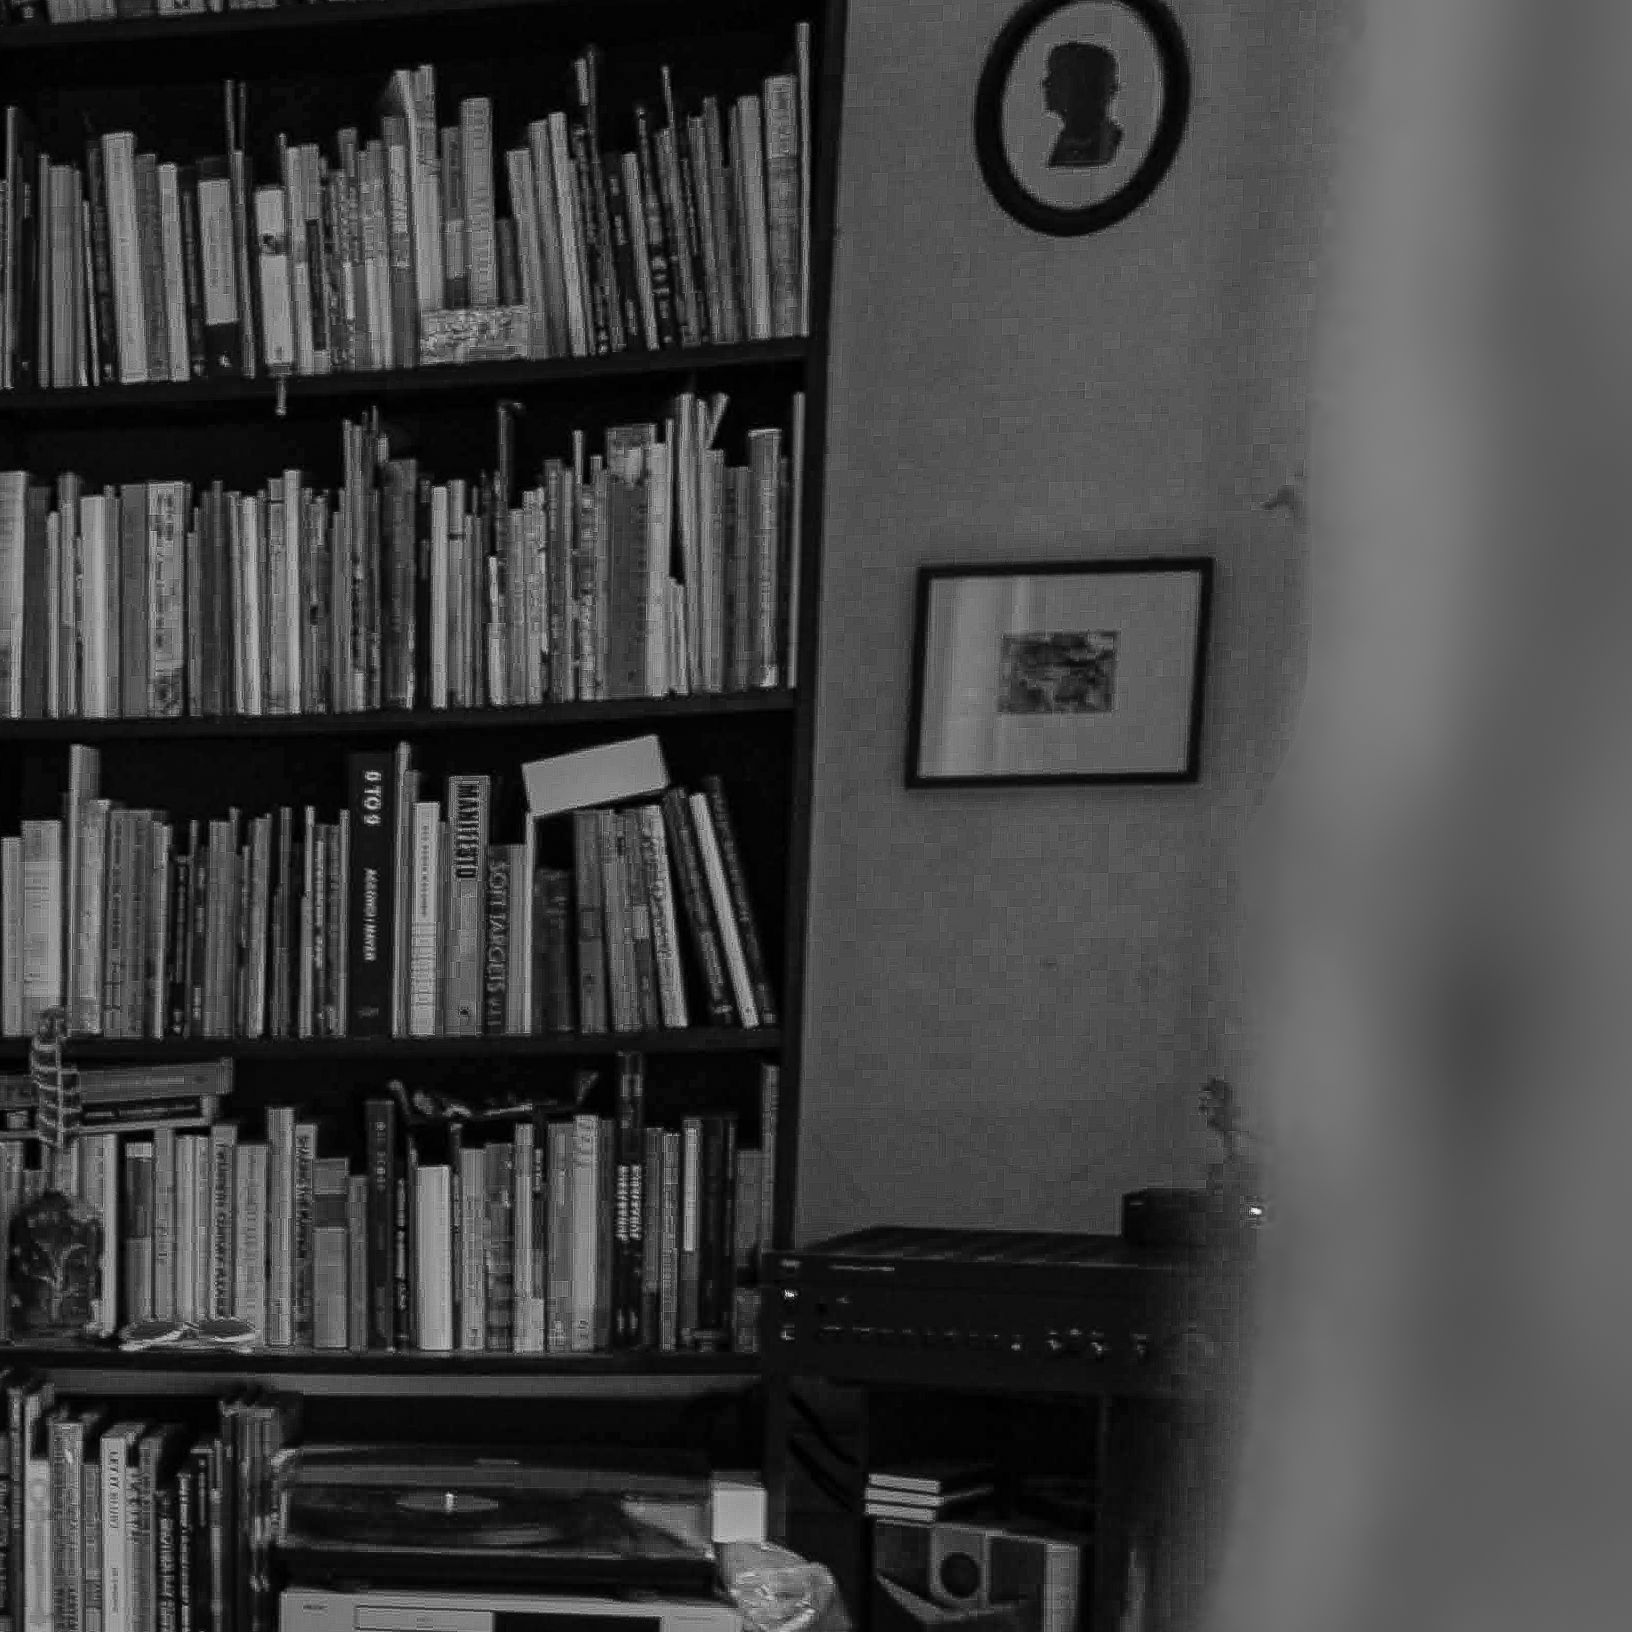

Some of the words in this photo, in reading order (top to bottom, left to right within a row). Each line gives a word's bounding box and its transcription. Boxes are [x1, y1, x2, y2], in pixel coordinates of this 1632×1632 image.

[364, 786, 382, 810] TO
[455, 785, 480, 879] MANIFESTO
[487, 862, 510, 906] SOFT
[487, 913, 507, 993] TARGETS
